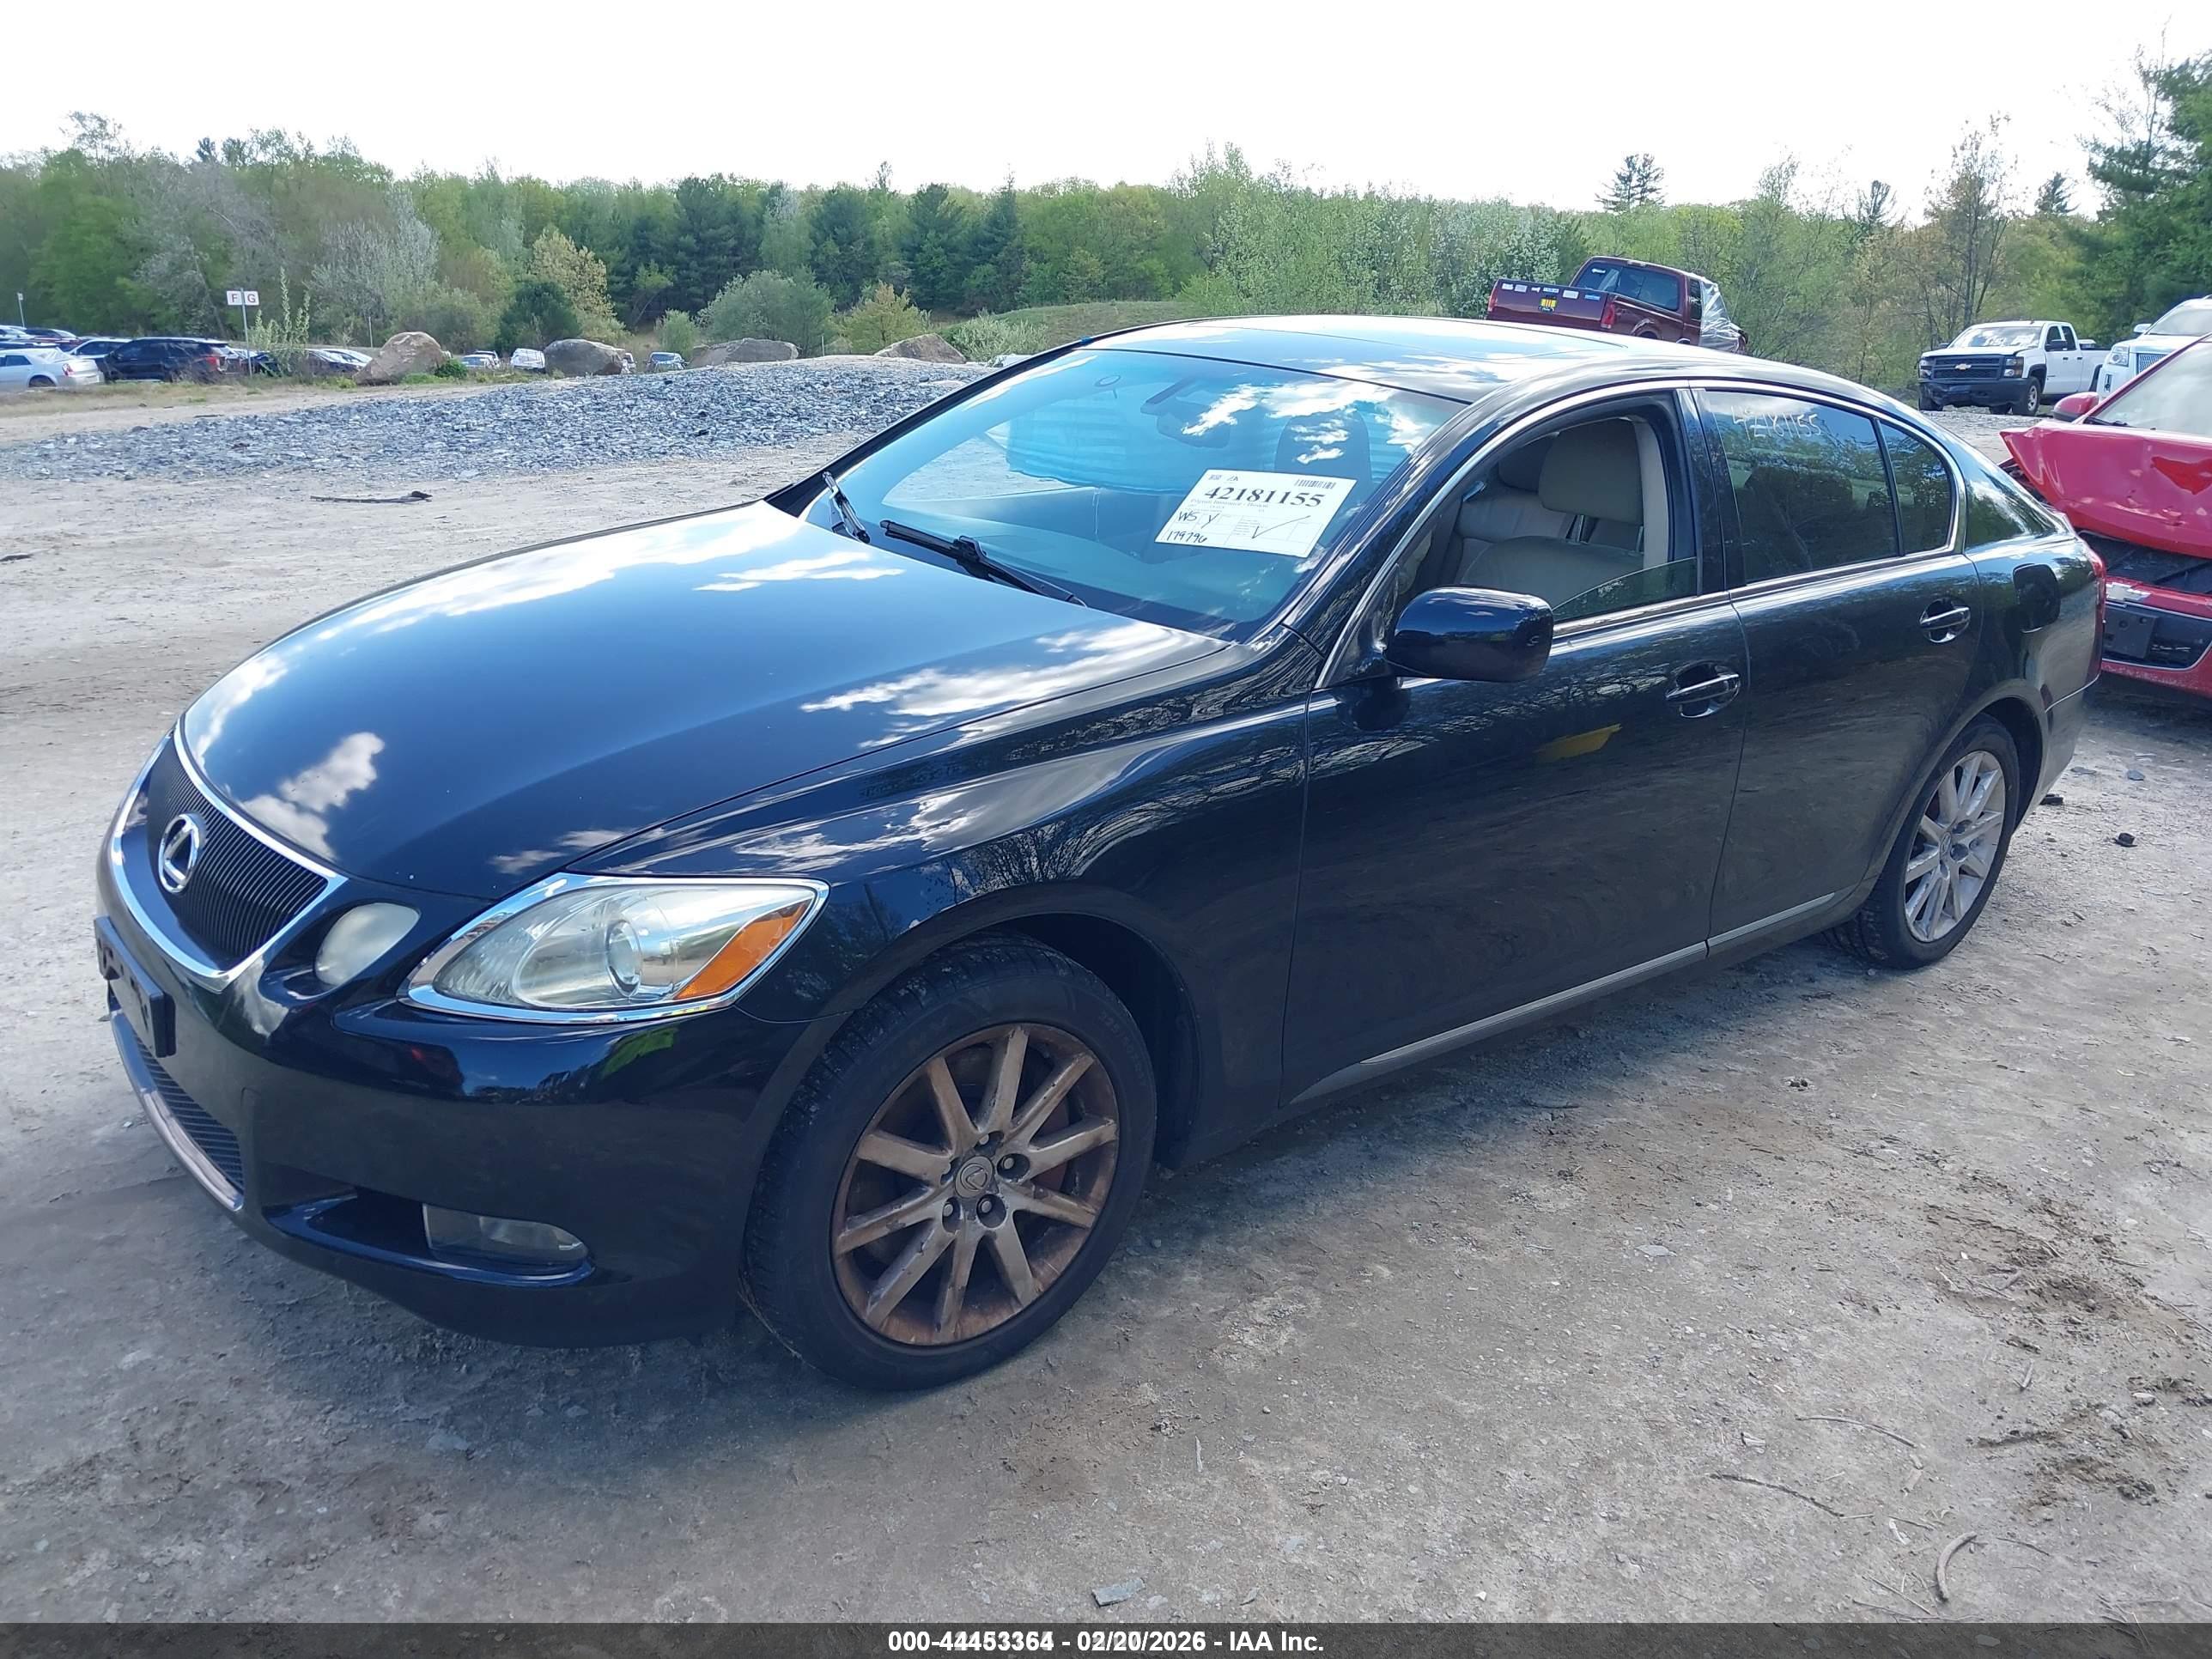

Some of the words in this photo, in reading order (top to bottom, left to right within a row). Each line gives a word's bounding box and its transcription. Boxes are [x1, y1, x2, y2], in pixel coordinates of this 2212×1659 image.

[232, 294, 237, 302] F
[247, 294, 256, 303] G
[1205, 486, 1326, 507] 42181155
